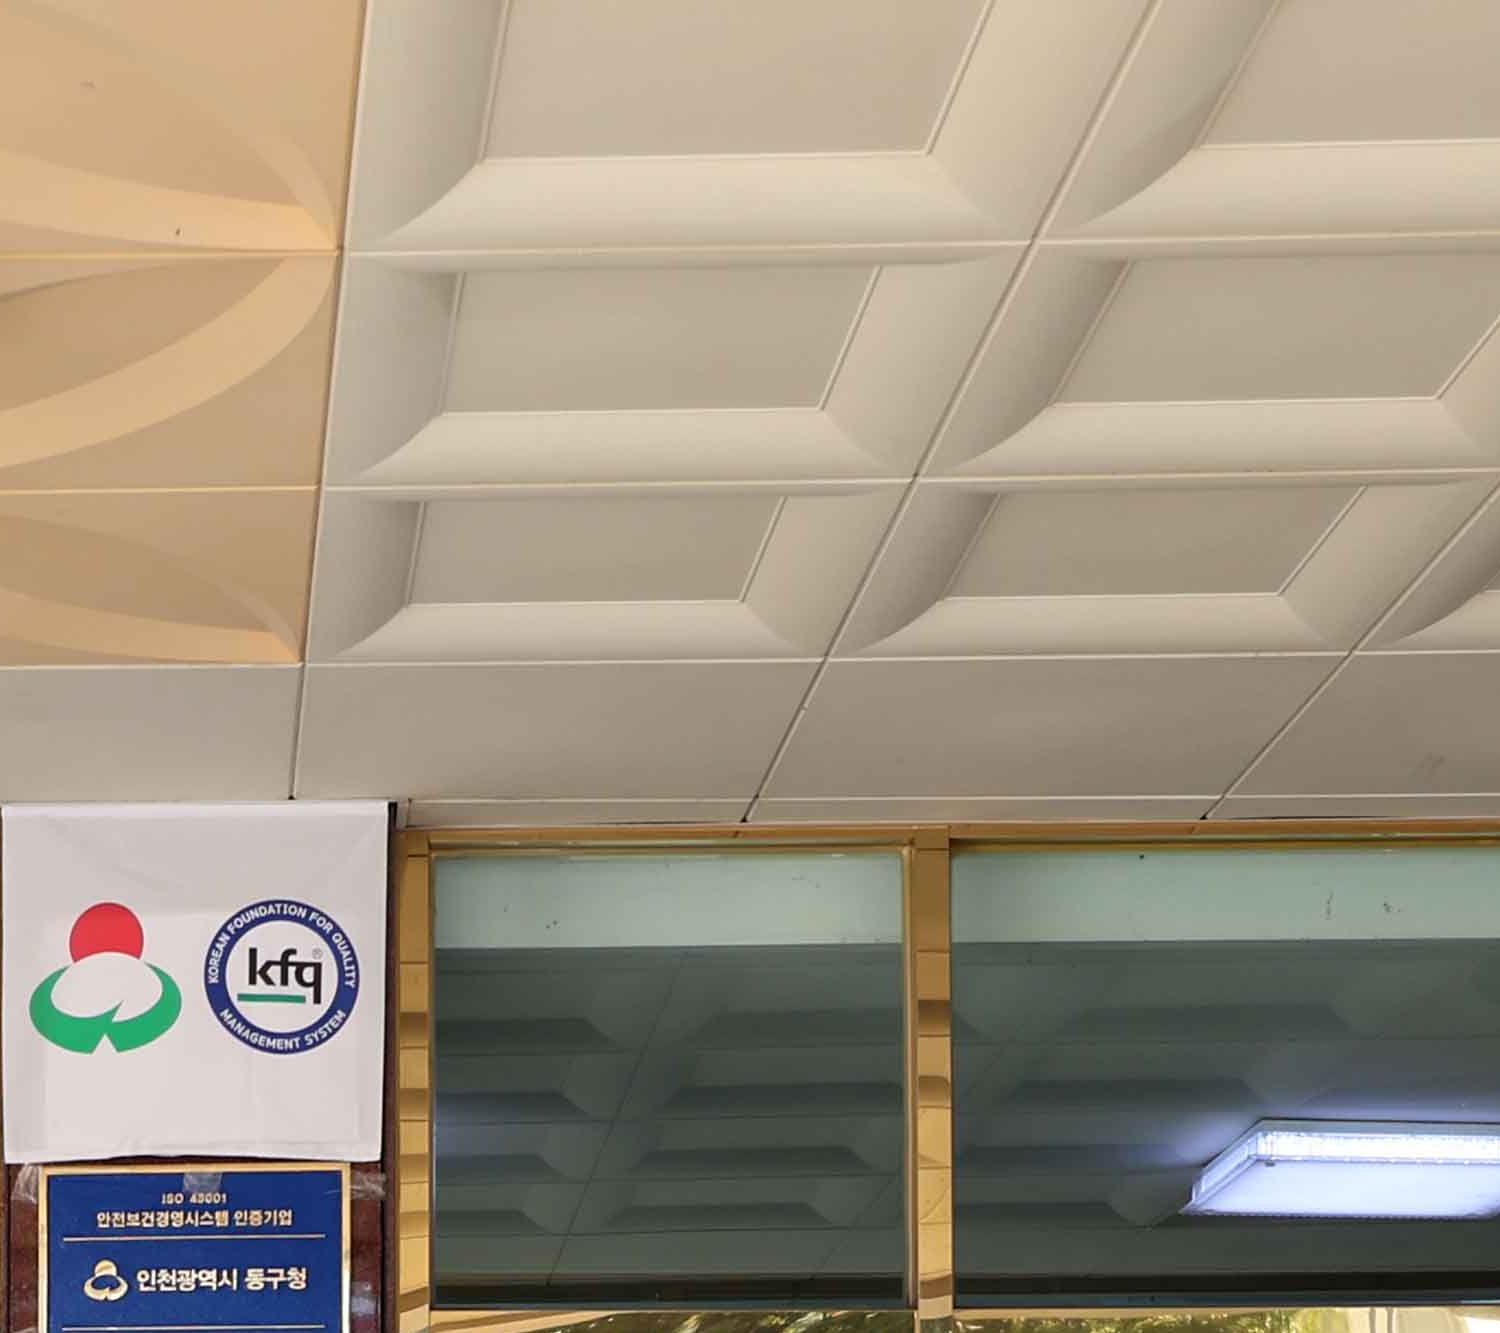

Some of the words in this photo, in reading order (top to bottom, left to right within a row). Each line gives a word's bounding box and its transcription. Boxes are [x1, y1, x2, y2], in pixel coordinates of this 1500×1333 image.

[208, 932, 230, 985] KOREAN
[227, 903, 308, 935] FOUNDATION
[309, 911, 333, 934] FOR
[331, 932, 356, 989] QUALITY
[248, 947, 322, 1005] kfq
[220, 1008, 301, 1050] MANAGEMENT
[304, 1009, 346, 1046] SYSTEM
[97, 1210, 230, 1228] 안전보건경영시스템
[234, 1209, 293, 1226] 인증기업
[136, 1268, 238, 1292] 인천광역시
[245, 1267, 308, 1291] 동구청
